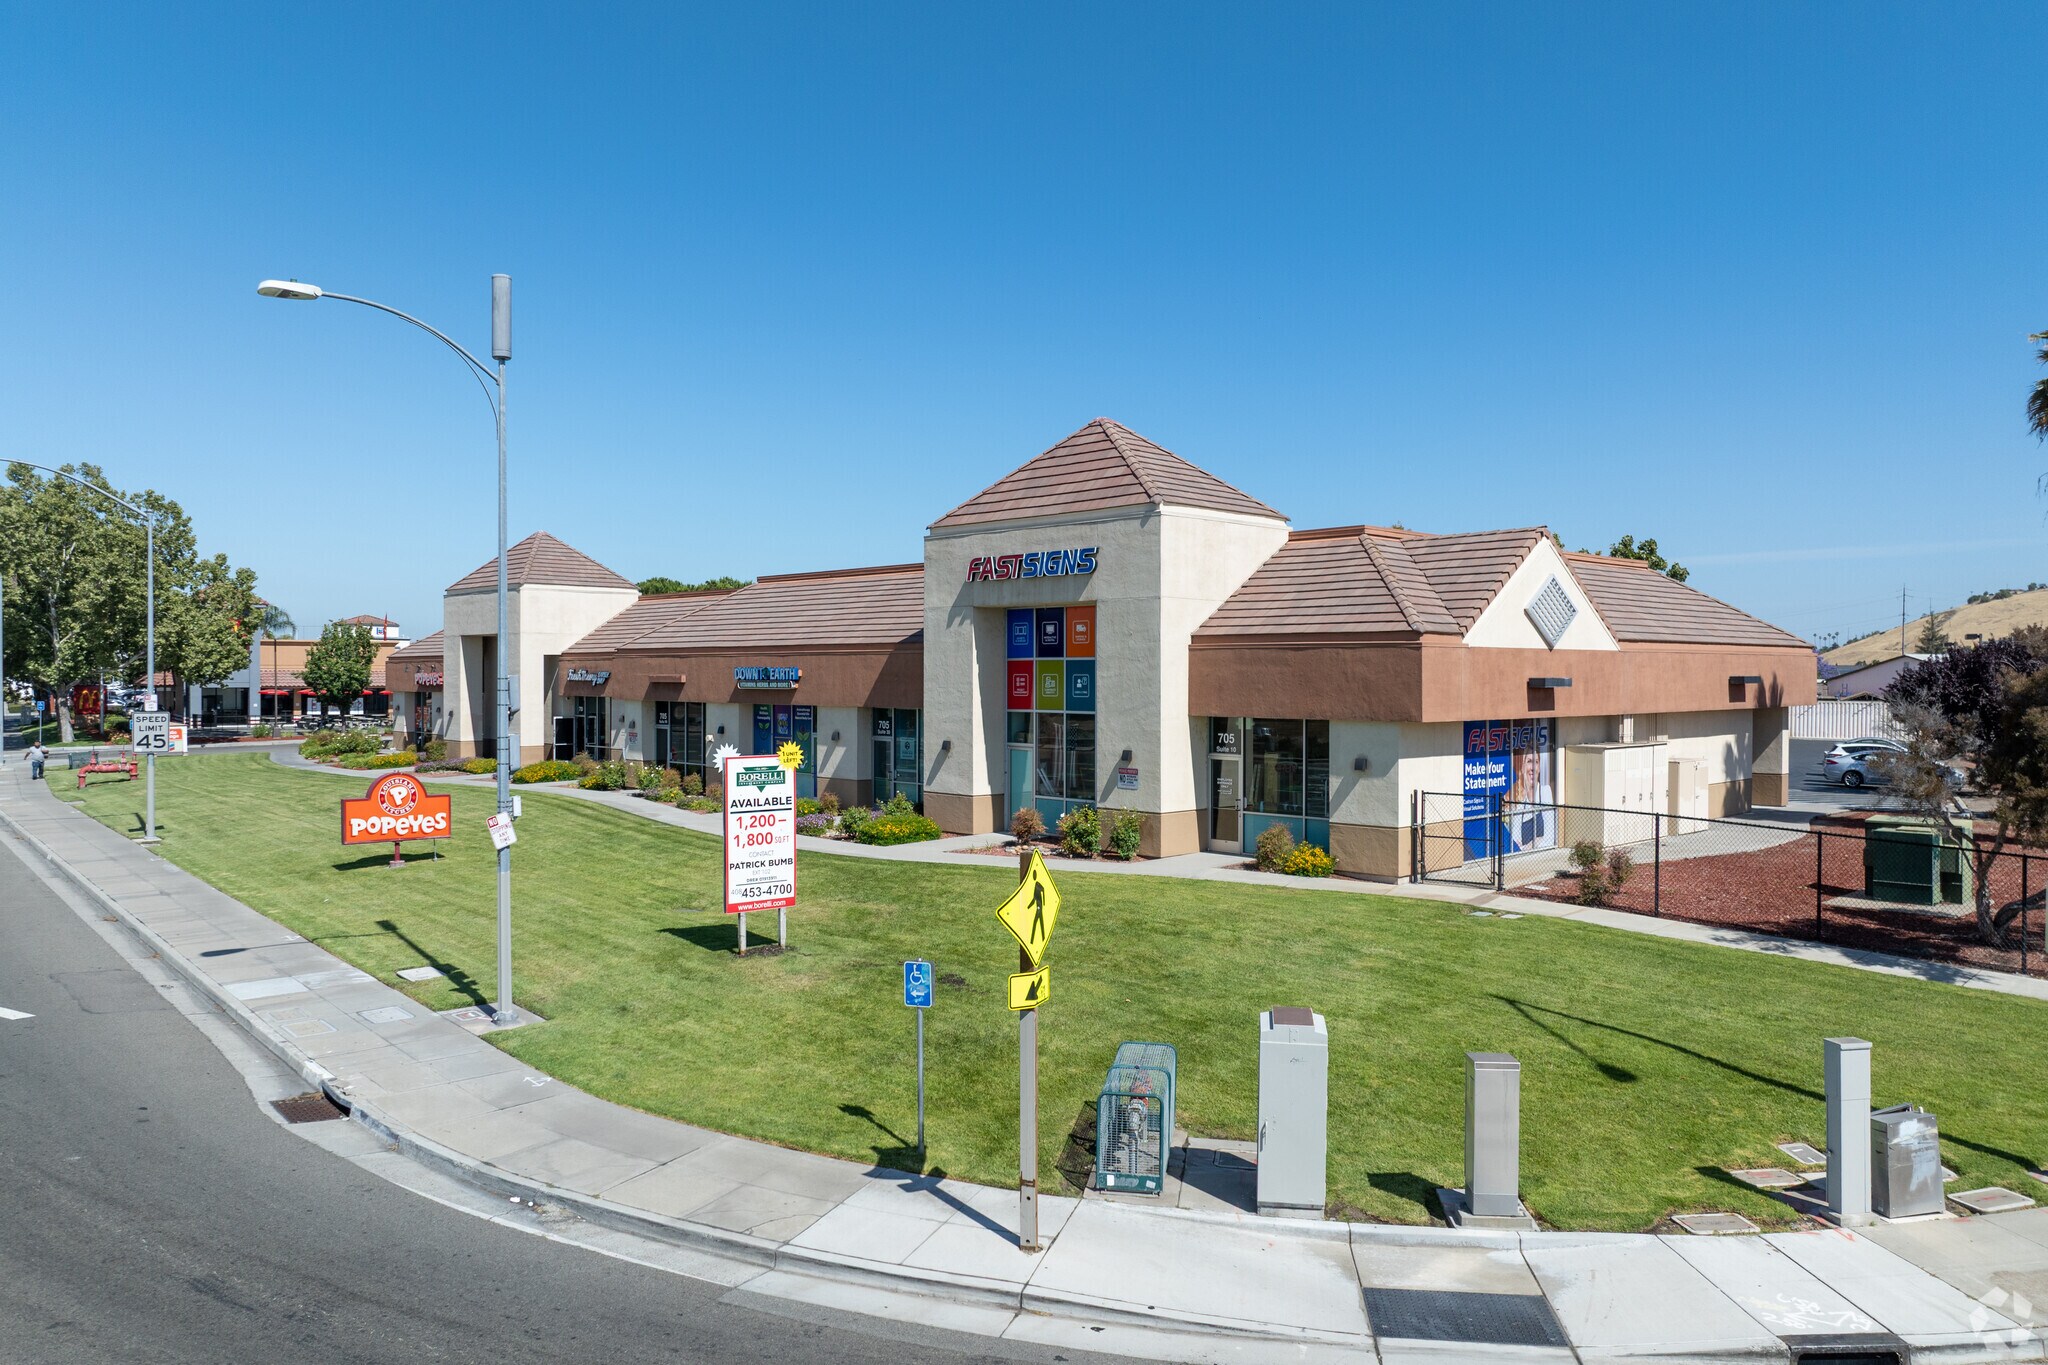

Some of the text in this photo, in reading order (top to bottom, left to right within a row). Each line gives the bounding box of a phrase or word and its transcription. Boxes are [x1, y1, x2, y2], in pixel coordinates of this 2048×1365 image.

[966, 546, 1098, 582] FASTSIGNS
[734, 668, 758, 680] DOWN
[770, 668, 795, 680] EARTH
[878, 721, 889, 729] 705
[136, 734, 166, 748] 45
[1218, 733, 1234, 743] 705
[1465, 762, 1504, 776] Make Your
[739, 772, 784, 781] BORELLI
[380, 779, 416, 795] LOUISIANA
[390, 786, 408, 806] P
[730, 796, 792, 808] AVAILABLE
[382, 802, 416, 814] KITCHEN
[736, 814, 776, 830] 1,200
[734, 832, 773, 848] 1,800
[730, 858, 793, 870] PATRICK BUMB
[742, 884, 792, 898] 453-4700
[738, 900, 786, 911] www.borelli.com
